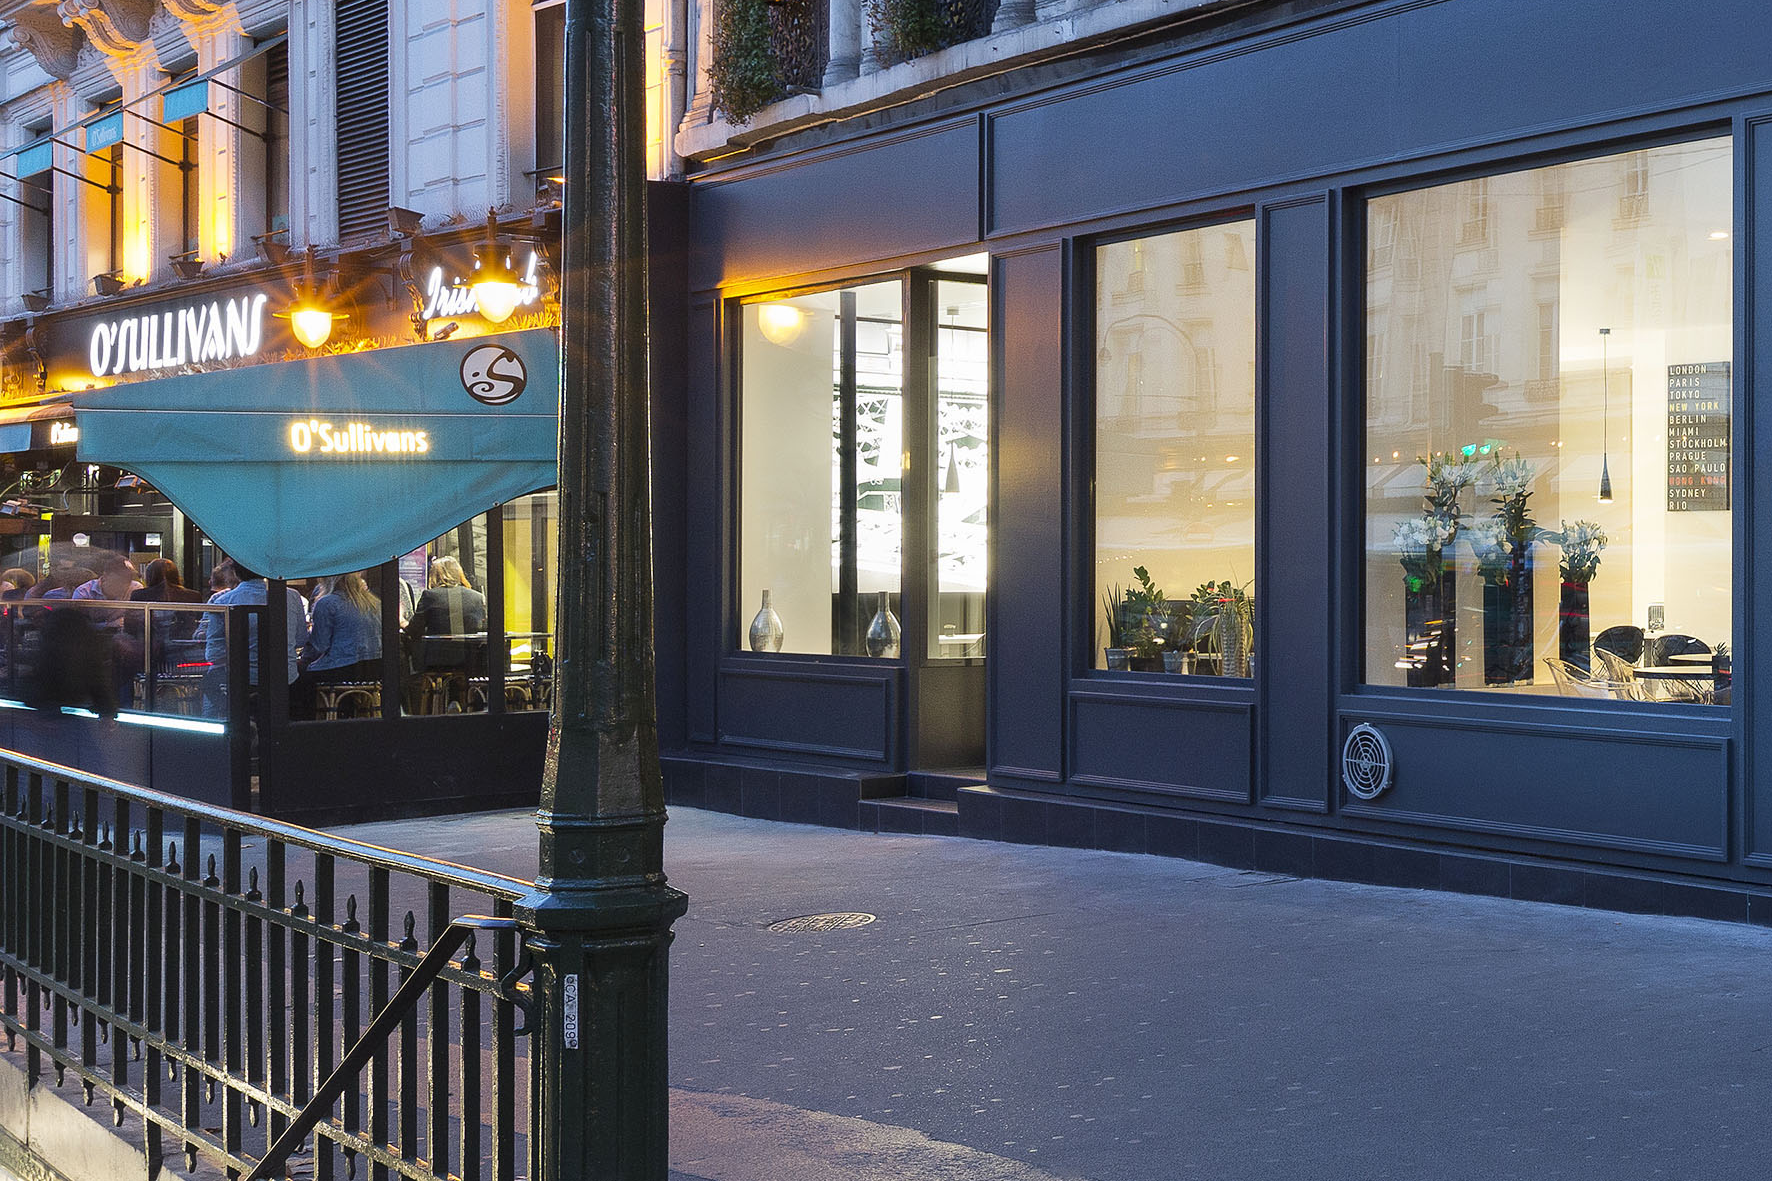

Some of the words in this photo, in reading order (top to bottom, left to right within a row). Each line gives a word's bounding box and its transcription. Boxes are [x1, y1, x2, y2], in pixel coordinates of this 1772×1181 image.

[90, 294, 267, 377] O'SULLIVANS
[1669, 365, 1707, 375] LONDON
[1669, 378, 1700, 387] PARIS
[1669, 390, 1700, 399] TOKYO
[1669, 403, 1688, 412] NEW
[1695, 402, 1719, 411] YORK
[1669, 414, 1707, 424] BERLIN
[291, 419, 428, 452] O'Sullivans
[1669, 427, 1699, 437] MIAMI
[1669, 438, 1727, 448] STOCKHOLM
[1669, 451, 1706, 461] PRAGUE
[1669, 464, 1687, 473] SAO
[1694, 463, 1726, 472] PAULO
[1669, 489, 1706, 498] SYDNEY
[1669, 501, 1687, 510] RIO
[565, 1014, 576, 1039] 209
